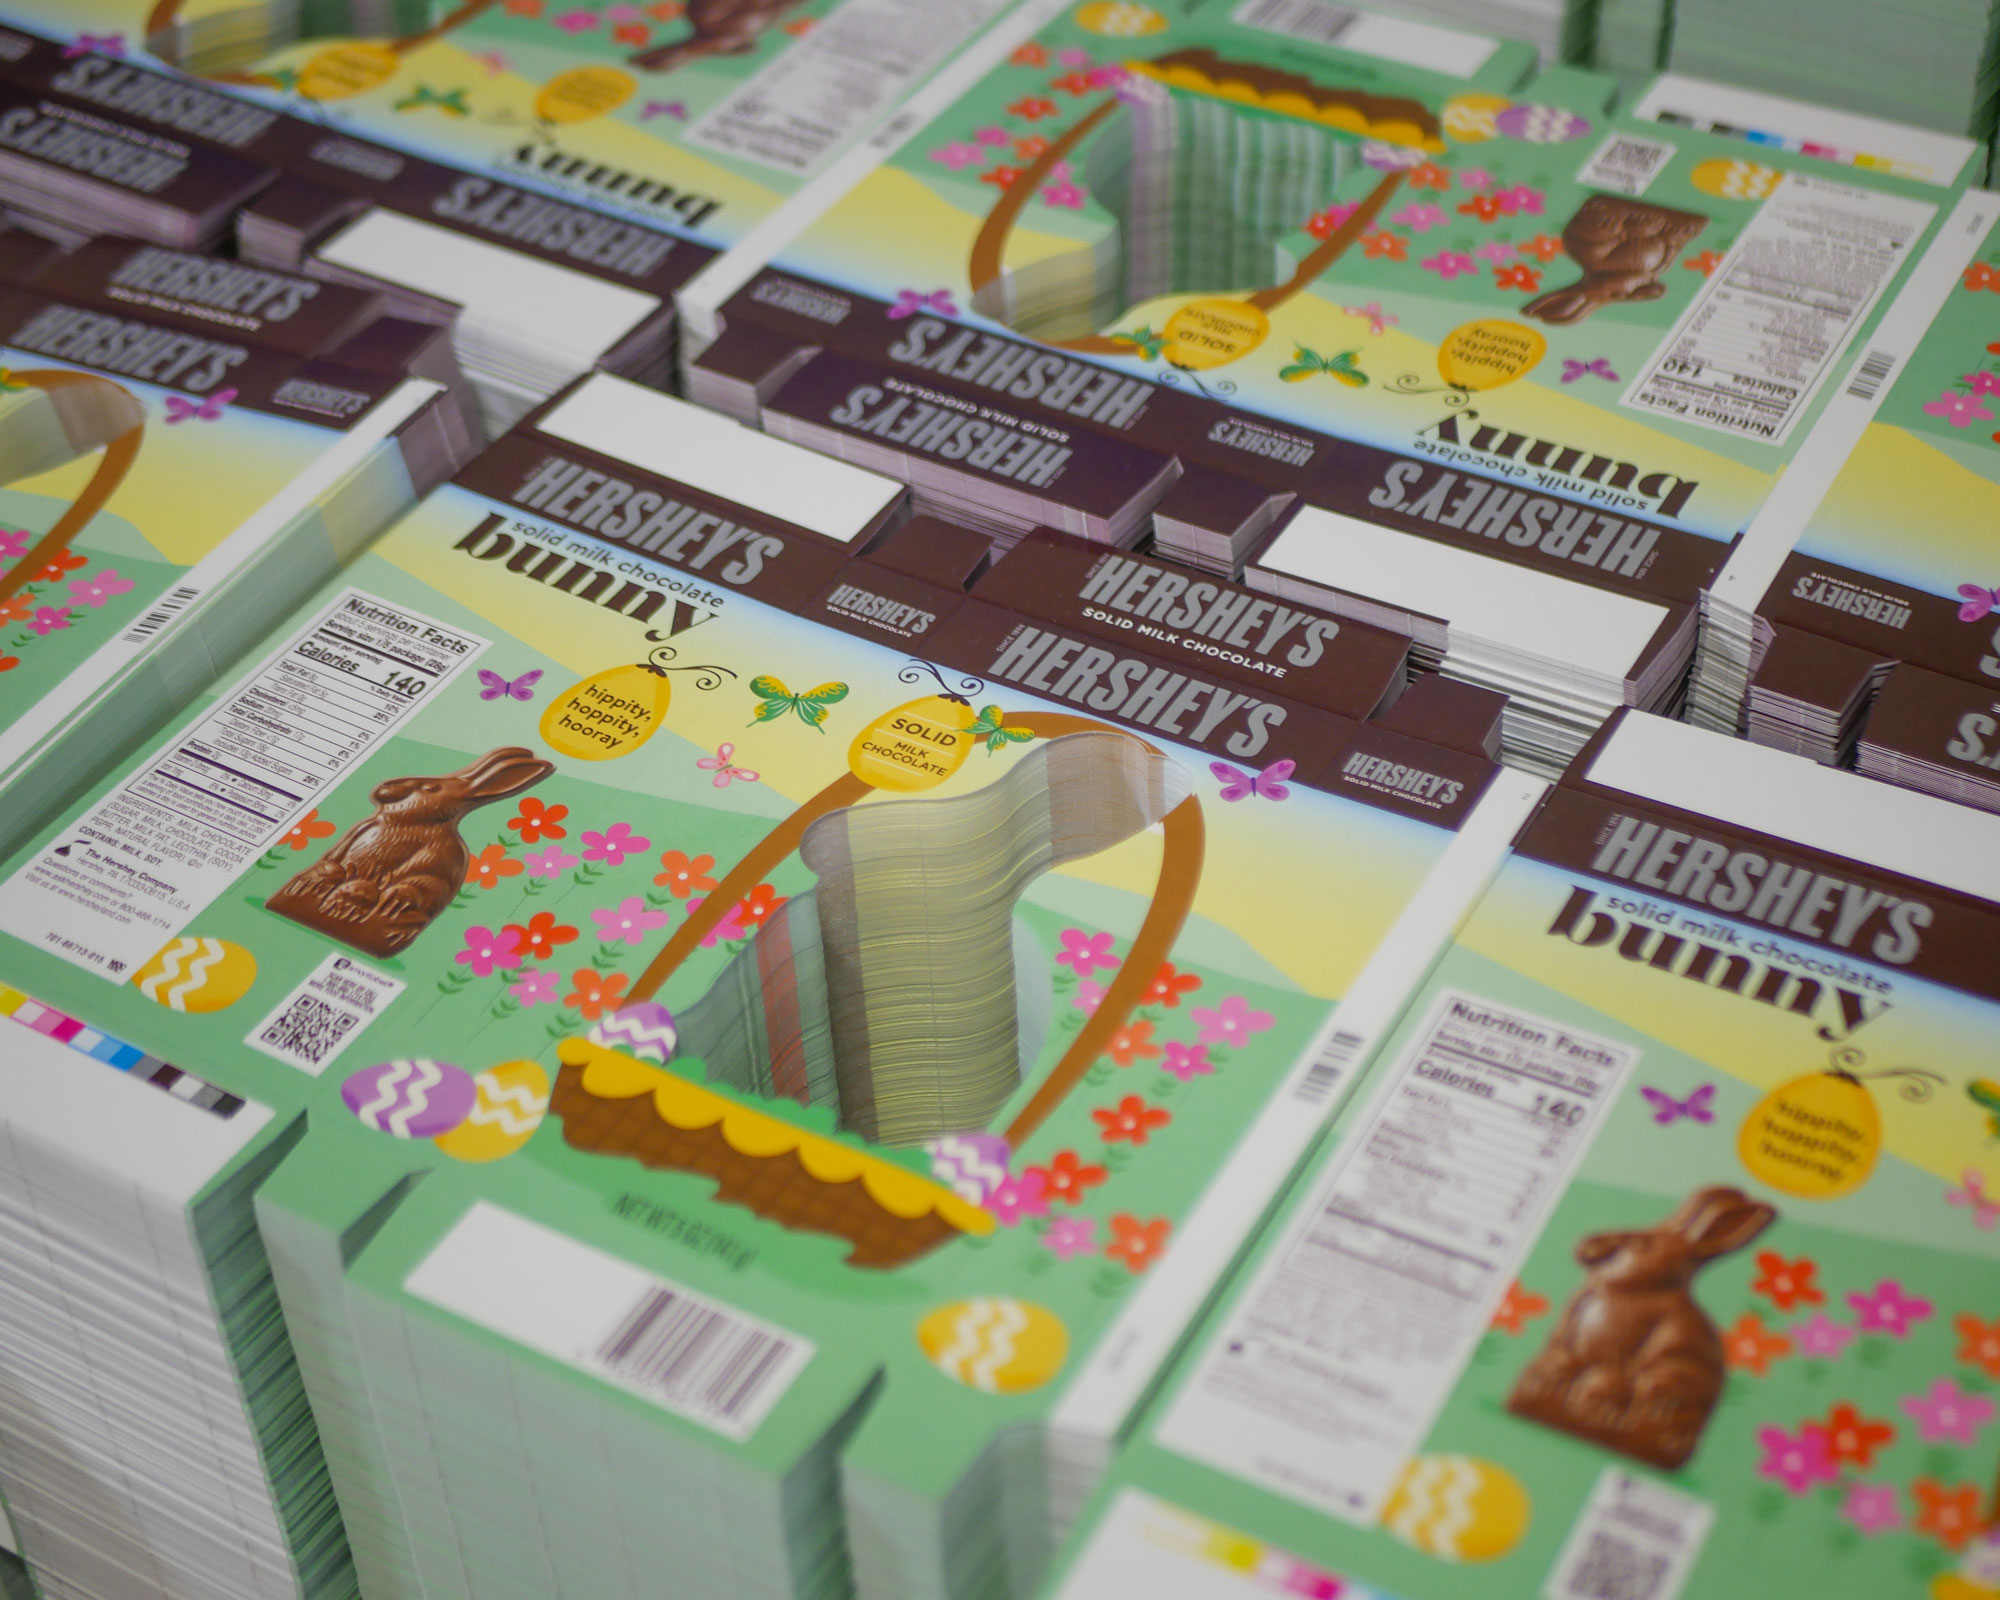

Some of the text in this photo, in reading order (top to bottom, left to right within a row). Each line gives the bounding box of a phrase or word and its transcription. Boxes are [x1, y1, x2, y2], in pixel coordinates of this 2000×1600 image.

[1179, 330, 1237, 354] SOLID
[889, 317, 1156, 430] HERSHEY'S
[1662, 358, 1701, 377] 140
[1733, 374, 1797, 400] Calories
[884, 377, 1070, 444] SOLID MILK CHOCOLATE
[1640, 392, 1688, 413] Facts
[1694, 407, 1775, 436] Nutrition
[830, 384, 1073, 488] HERSHEY'S
[1207, 421, 1315, 467] HERSHEY'S
[1412, 440, 1650, 511] solid milk chocolate
[1415, 410, 1700, 521] bunny
[511, 457, 784, 585] HERSHEY'S
[1368, 460, 1662, 578] HERSHEY'S
[452, 511, 720, 643] bunny
[512, 520, 725, 608] solid milk chocolate
[827, 584, 936, 635] HERSHEY'S
[1078, 554, 1340, 668] HERSHEY'S
[1792, 576, 1912, 630] HERSHEY'S
[324, 618, 357, 637] Serving
[356, 632, 375, 643] size
[388, 645, 425, 662] package
[344, 598, 468, 653] Nutrition Facts
[868, 618, 913, 639] CHOCOLATE
[1081, 606, 1288, 679] SOLID MILK CHOCOLATE
[279, 660, 298, 672] Total
[296, 667, 310, 677] Fat
[298, 640, 426, 695] Calories 140
[311, 632, 341, 647] Amount
[354, 649, 383, 665] serving
[237, 695, 264, 710] Sodium
[248, 687, 286, 706] Cholesterol
[584, 684, 652, 723] hippity,
[987, 626, 1288, 758] HERSHEY'S
[228, 704, 248, 716] Total
[246, 712, 291, 734] Carbohydrate
[558, 714, 624, 750] hooray
[567, 697, 640, 738] hoppity,
[892, 718, 957, 747] SOLID
[186, 740, 212, 755] Protein
[862, 741, 948, 777] CHOCOLATE
[894, 741, 930, 759] MILK
[1342, 752, 1465, 804] HERSHEY'S
[1391, 789, 1443, 810] CHOCOLATE
[114, 826, 150, 846] NATURAL
[131, 822, 155, 836] MILK
[170, 839, 209, 860] LECITHIN
[176, 818, 198, 833] MILK
[200, 829, 253, 856] CHOCOLATE
[214, 846, 244, 864] COCOA
[41, 857, 80, 877] Questions
[85, 847, 177, 894] The Hershey Company
[1592, 814, 1935, 965] HERSHEY'S
[1547, 885, 1895, 1043] bunny
[1606, 895, 1894, 994] solid milk chocolate
[1451, 1002, 1545, 1041] Nutrition
